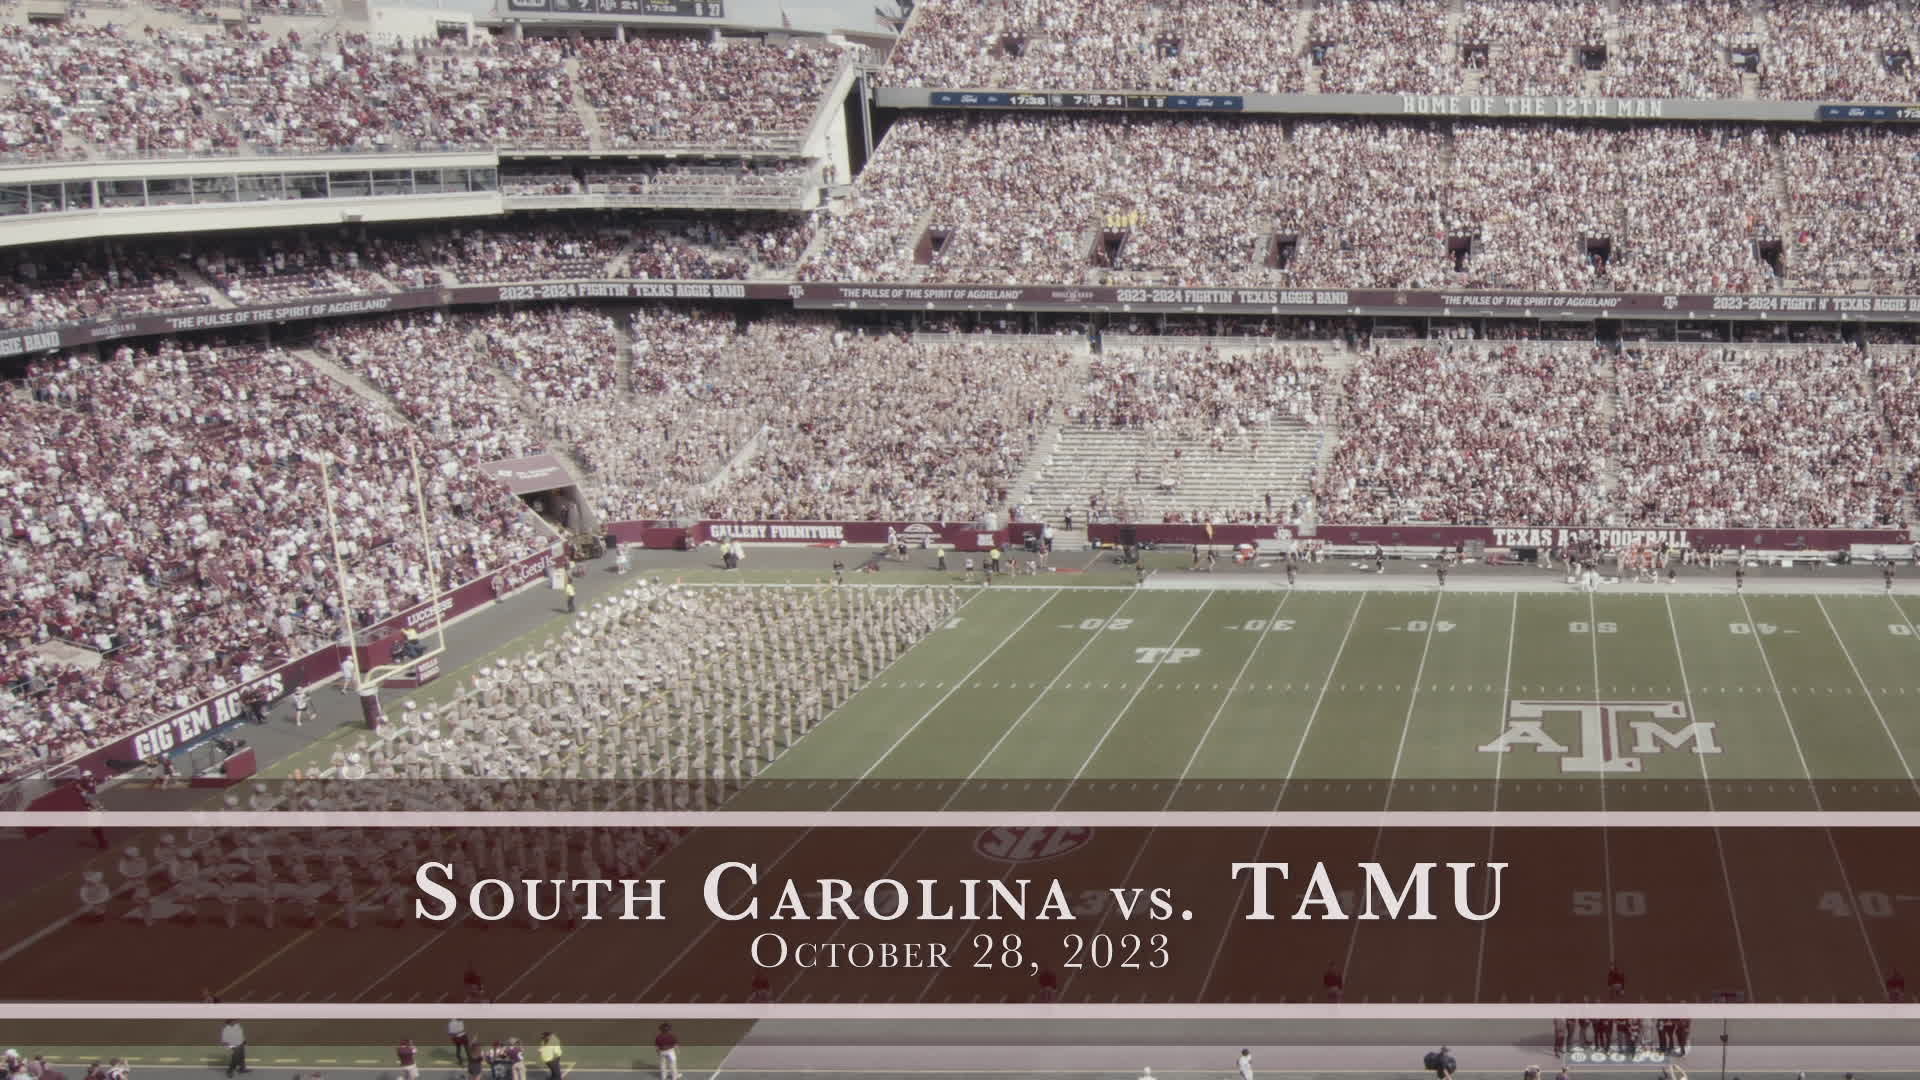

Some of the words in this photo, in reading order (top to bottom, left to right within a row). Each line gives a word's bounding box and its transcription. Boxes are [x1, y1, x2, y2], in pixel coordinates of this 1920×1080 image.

[1403, 97, 1460, 114] HOME
[1470, 97, 1495, 115] OF
[1504, 98, 1546, 116] THE
[1555, 99, 1608, 117] 12TH
[1617, 99, 1662, 118] MAN
[499, 284, 577, 300] 2023-2024
[633, 283, 674, 298] TEXAS
[676, 284, 711, 298] AGGIE
[712, 284, 746, 299] BAND
[862, 288, 890, 300] PULSE
[891, 288, 904, 300] OF
[905, 289, 922, 300] THE
[923, 289, 951, 300] SPIRIT
[952, 289, 966, 300] OF
[1116, 289, 1182, 303] 2023-2024
[1238, 290, 1278, 304] TEXAS
[1280, 291, 1314, 305] AGGIE
[1315, 291, 1349, 305] BAND
[1463, 295, 1491, 306] PULSE
[1492, 296, 1504, 306] OF
[1505, 296, 1522, 307] THE
[1523, 296, 1551, 307] SPIRIT
[1552, 297, 1567, 308] OF
[1713, 297, 1778, 310] 2023-2024
[1832, 298, 1871, 311] TEXAS
[1873, 299, 1907, 312] AGGIE
[196, 312, 233, 327] PULSE
[234, 311, 250, 324] OF
[252, 308, 274, 321] THE
[275, 304, 310, 319] SPIRIT
[312, 303, 326, 316] OF
[23, 331, 60, 352] BAND
[710, 524, 767, 539] GALLERY
[770, 525, 844, 540] FURNITURE
[1492, 528, 1553, 547] TEXAS
[1600, 529, 1691, 549] FOOTBALL
[1568, 620, 1618, 634] 50
[134, 722, 174, 761] GIG
[1571, 891, 1649, 917] 50
